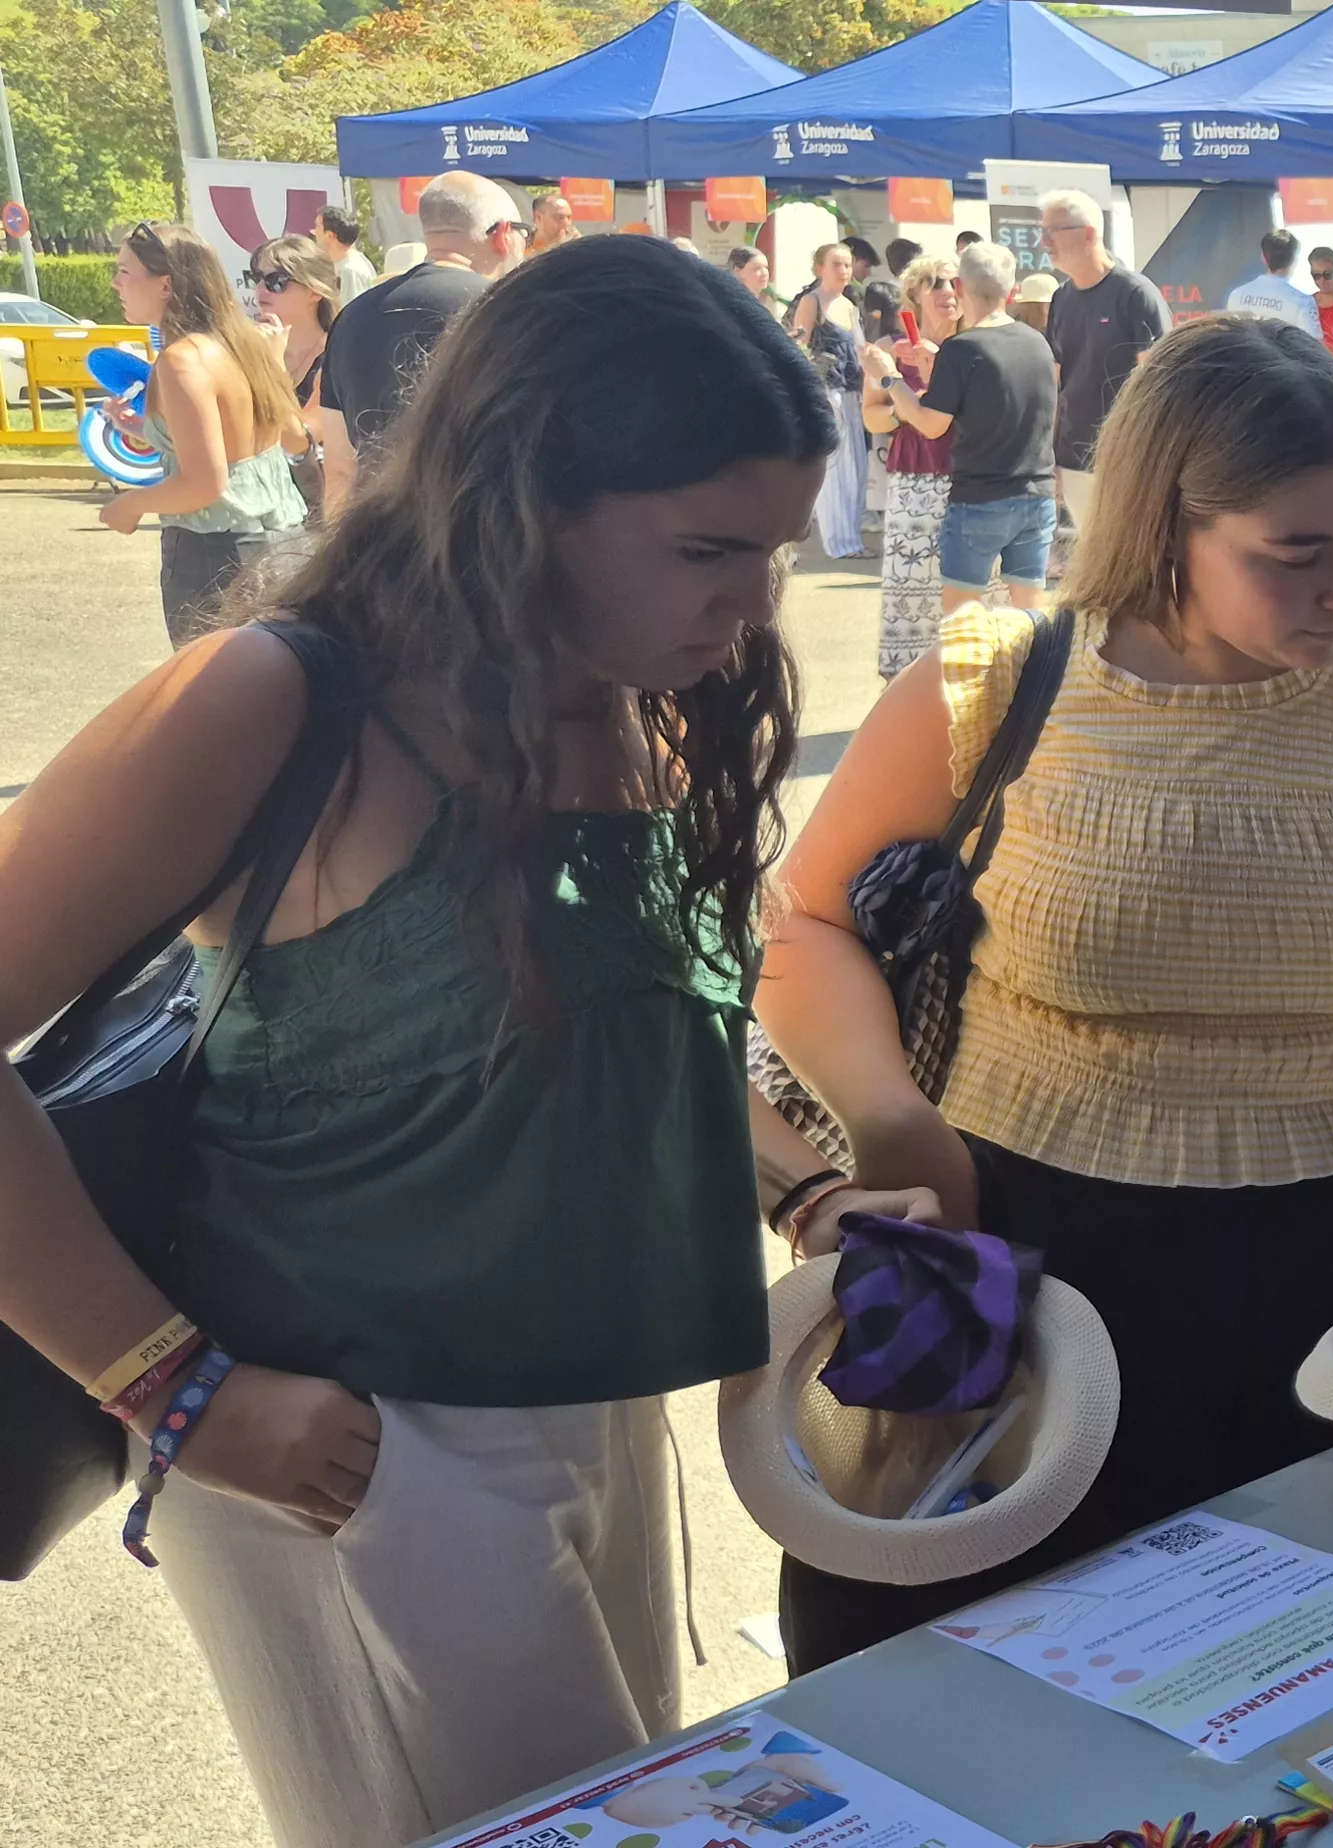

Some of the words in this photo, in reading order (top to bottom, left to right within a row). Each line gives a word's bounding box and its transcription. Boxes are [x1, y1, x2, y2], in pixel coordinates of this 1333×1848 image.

[464, 124, 530, 143] Universidad
[797, 121, 874, 142] Universidad
[1191, 121, 1280, 142] Universidad
[466, 142, 508, 158] Zaragoza
[800, 140, 849, 157] Zaragoza
[1192, 141, 1251, 159] Zaragoza
[1178, 285, 1202, 303] LA
[138, 1335, 173, 1363] PINK
[1197, 1545, 1269, 1577] Compensación
[1269, 1557, 1301, 1571] Plazo
[1213, 1577, 1261, 1599] solicitud
[1297, 1639, 1328, 1653] qué
[1244, 1651, 1306, 1681] consiste?
[1178, 1659, 1263, 1701] discapacidad
[832, 1814, 865, 1828] con
[827, 1821, 875, 1843] ¿Eres
